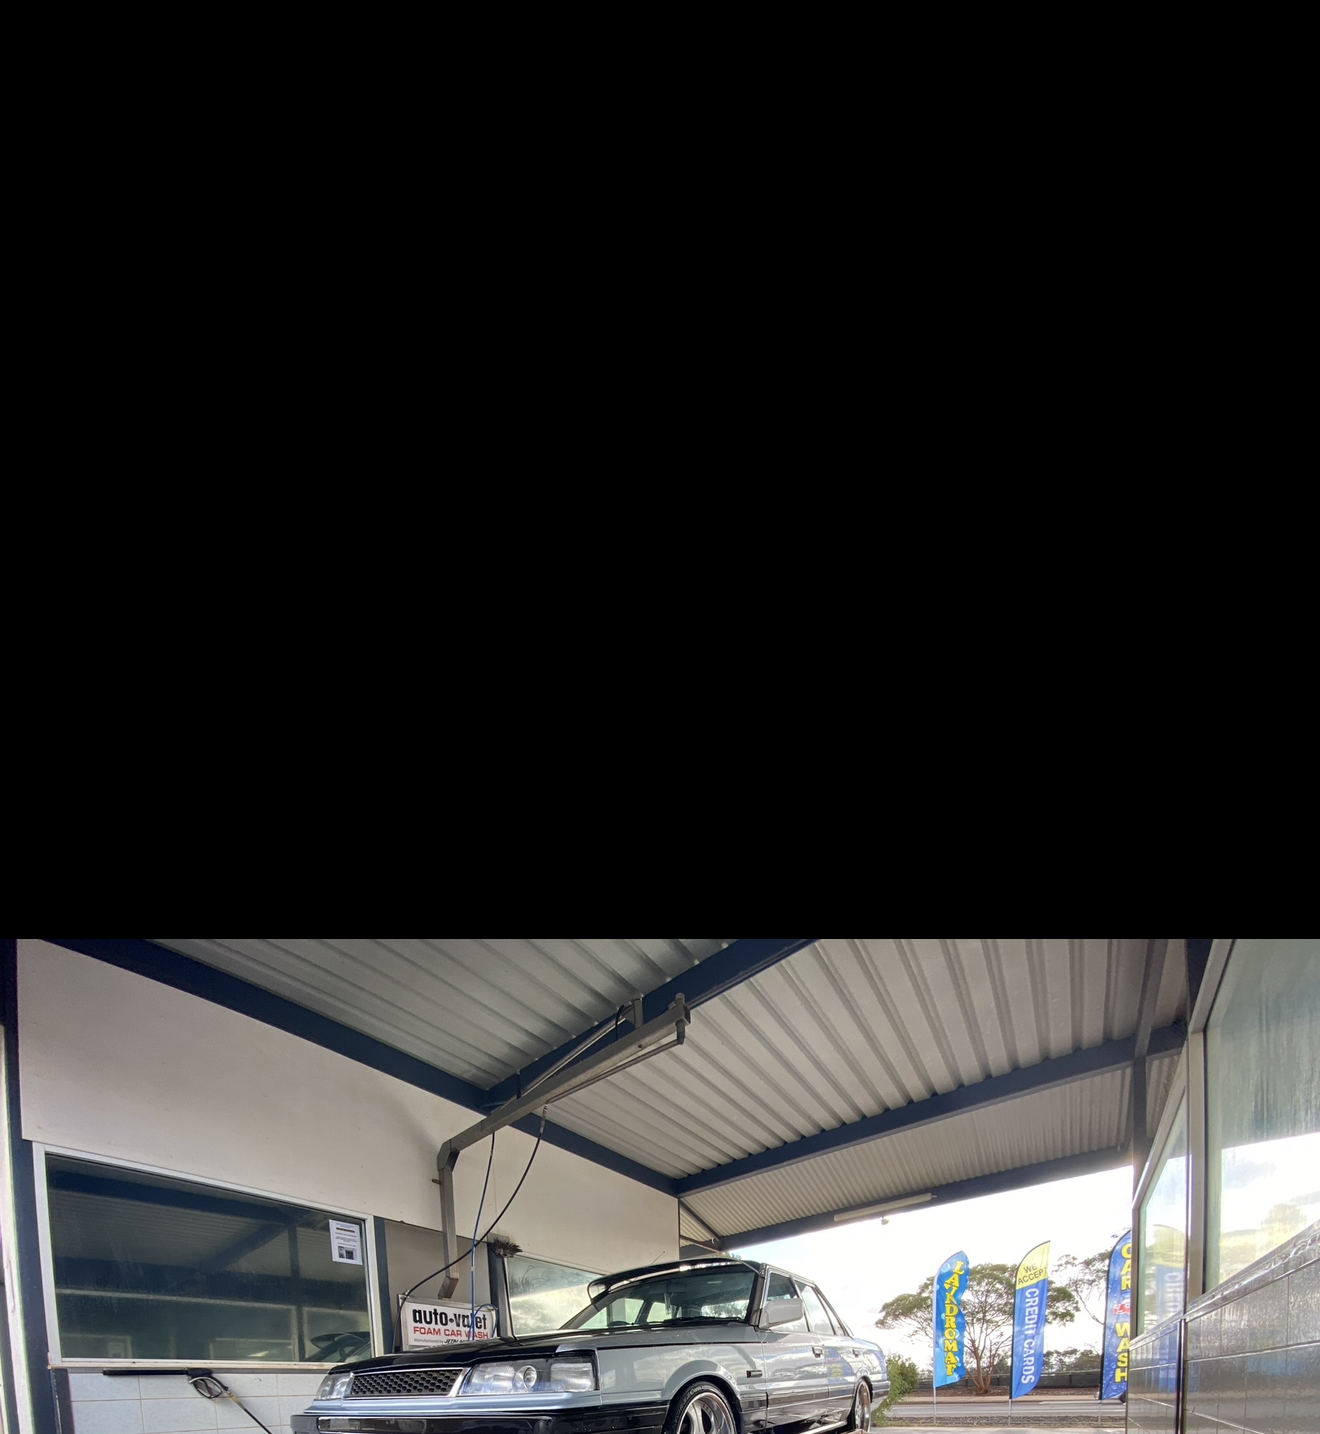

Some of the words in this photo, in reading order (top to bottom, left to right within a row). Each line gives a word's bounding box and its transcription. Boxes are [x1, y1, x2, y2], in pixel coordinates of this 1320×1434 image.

[1017, 1266, 1048, 1285] ACCEPT
[1023, 1263, 1038, 1274] WE
[1024, 1288, 1039, 1336] CREDIT
[413, 1326, 441, 1336] FOAM
[443, 1329, 462, 1337] CAR
[1021, 1339, 1035, 1384] CARDS
[1114, 1322, 1131, 1383] WASH
